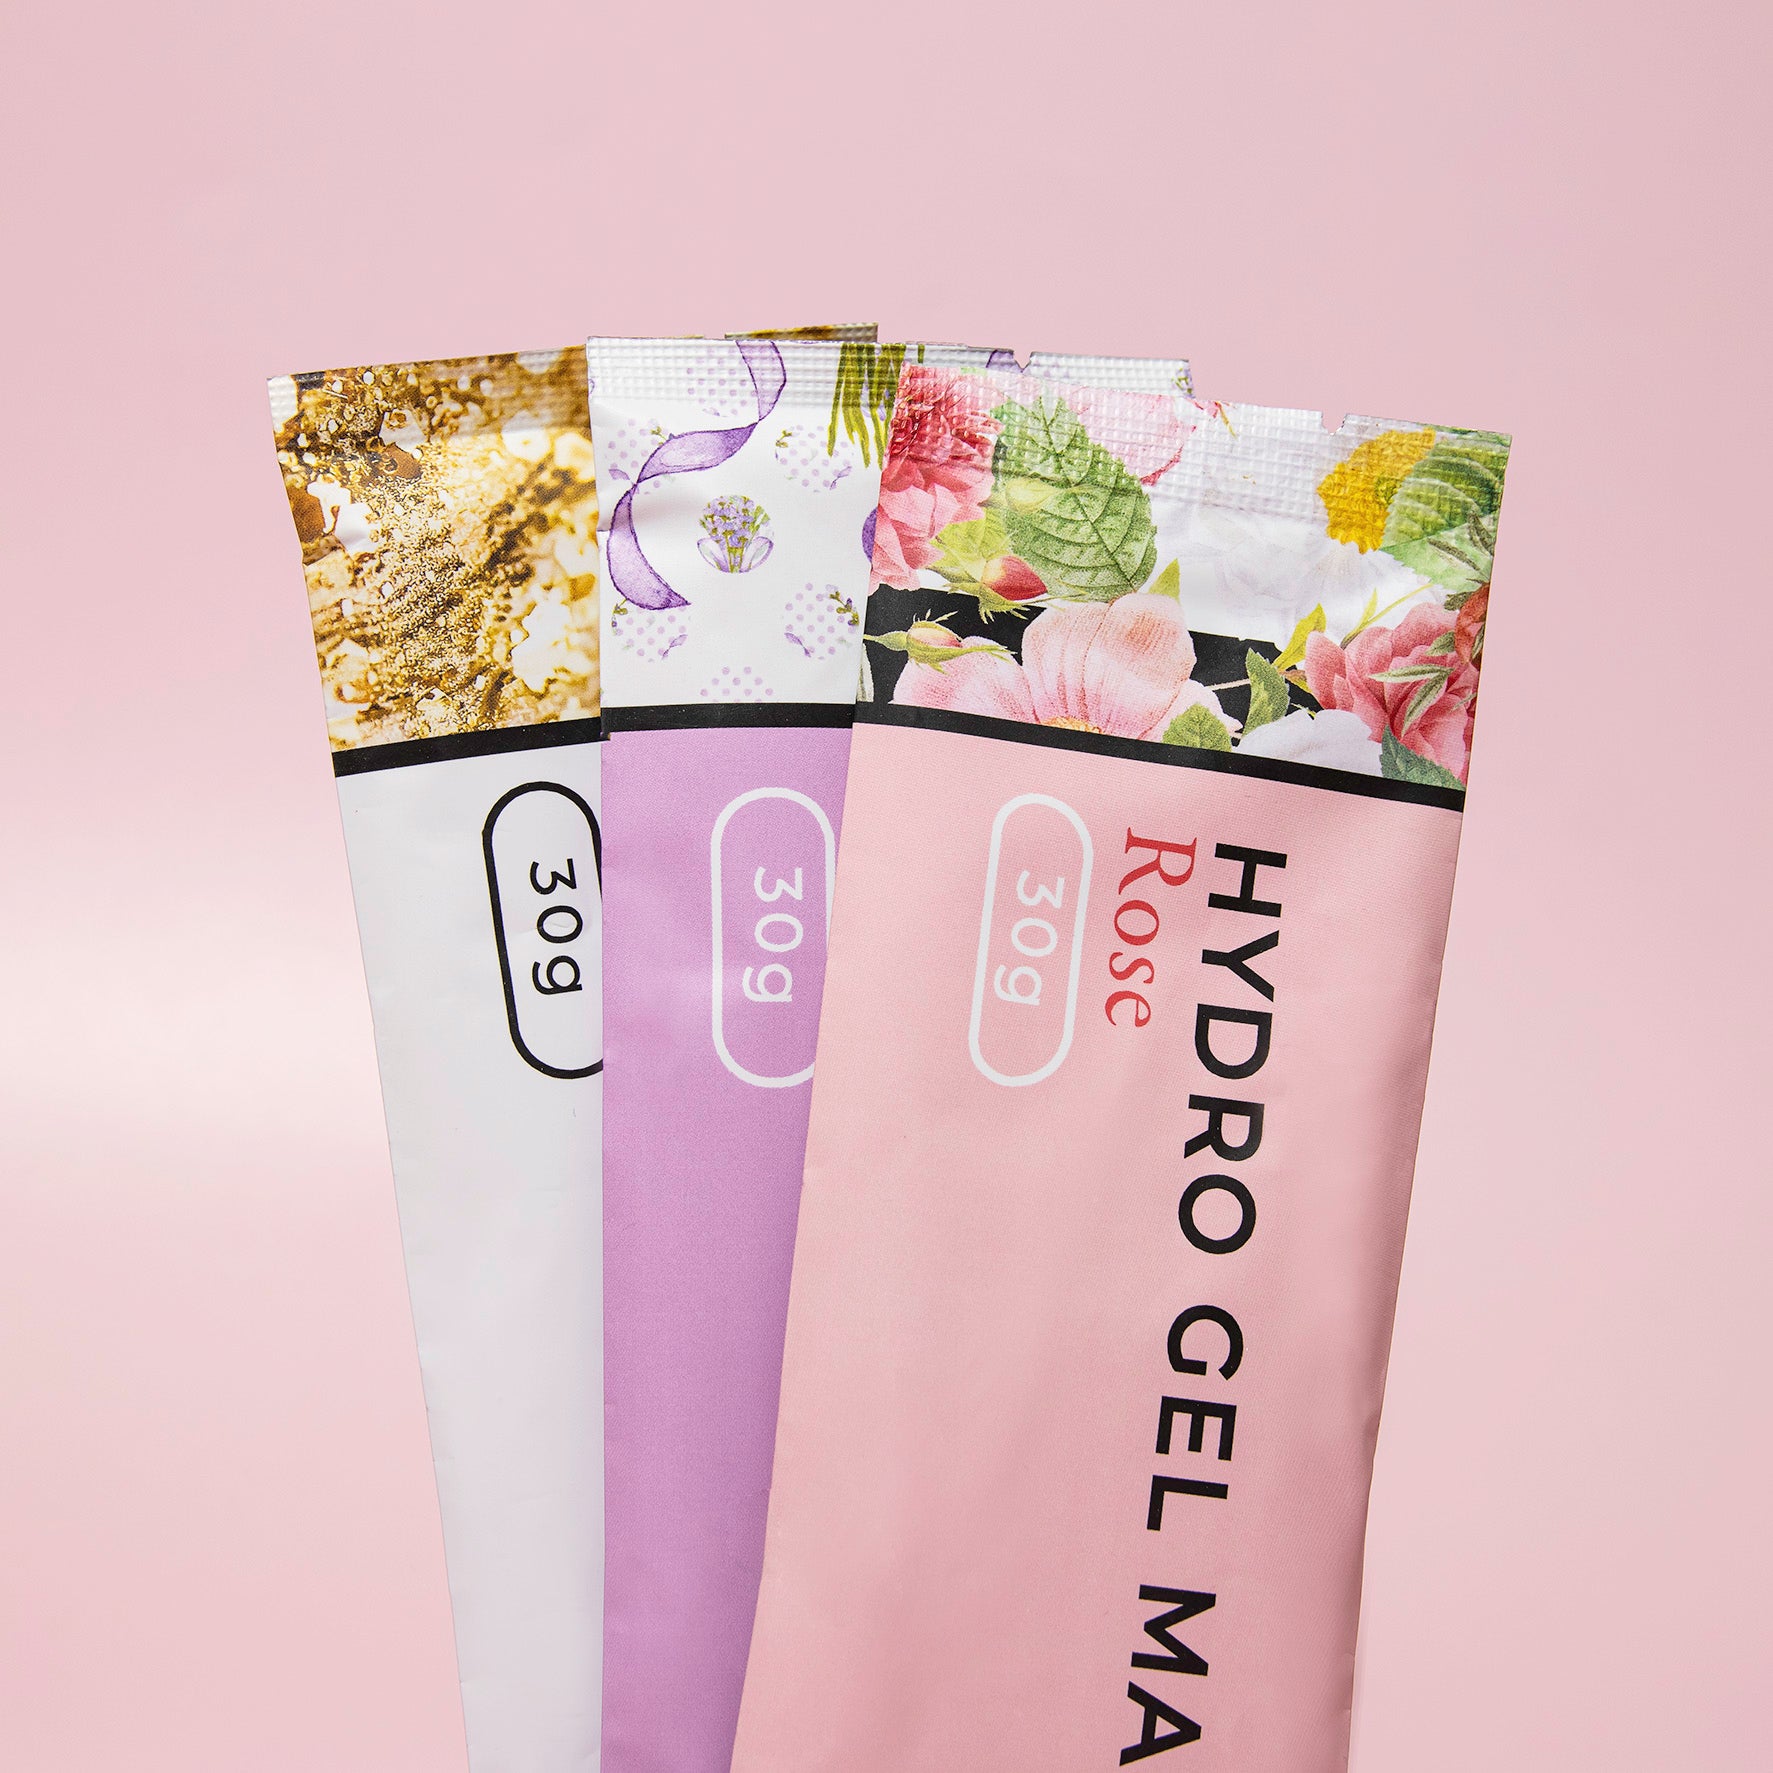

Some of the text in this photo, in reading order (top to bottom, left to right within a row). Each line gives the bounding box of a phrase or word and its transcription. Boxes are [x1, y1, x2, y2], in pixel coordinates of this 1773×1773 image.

[530, 857, 584, 996] 30g
[742, 866, 805, 1004] 30g
[993, 869, 1066, 1007] 30g
[1104, 826, 1198, 1029] Rose
[1178, 842, 1288, 1255] HYDRO
[1146, 1304, 1244, 1532] GEL
